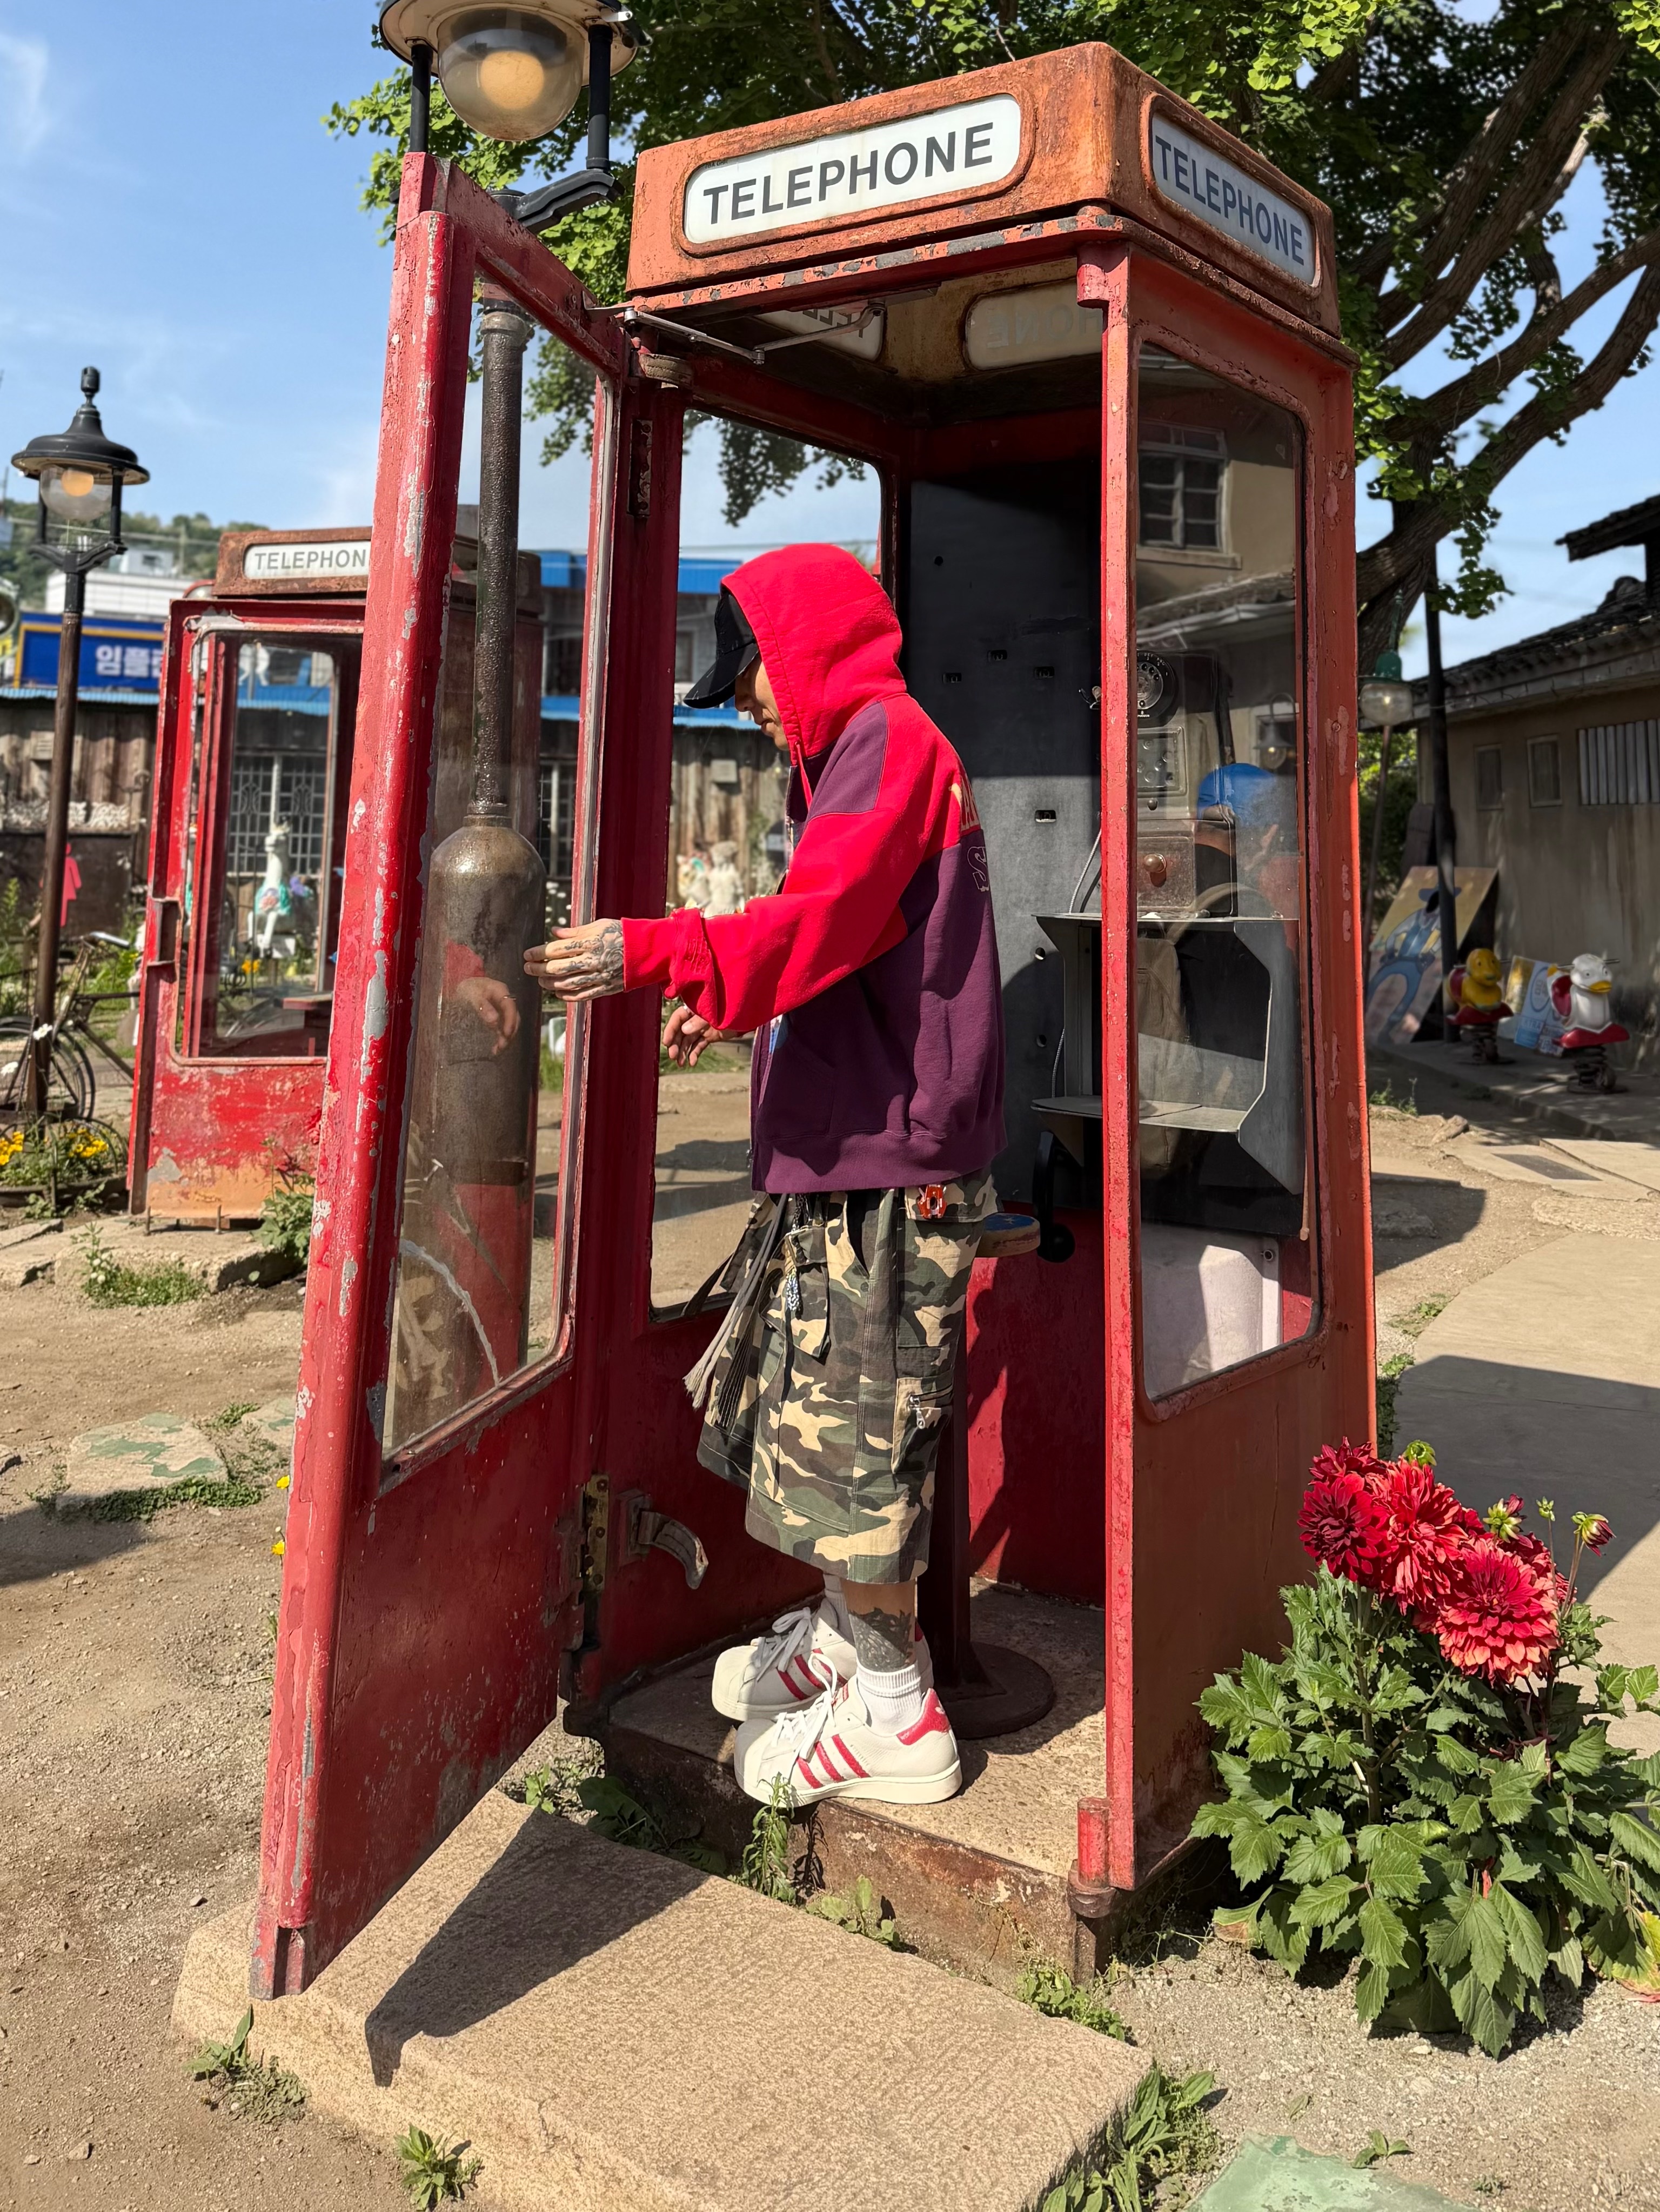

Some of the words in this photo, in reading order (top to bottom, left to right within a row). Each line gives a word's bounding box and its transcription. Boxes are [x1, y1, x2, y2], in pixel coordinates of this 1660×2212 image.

[703, 122, 994, 225] TELEPHONE
[1155, 135, 1304, 266] TELEPHONE
[254, 548, 367, 571] TELEPHON
